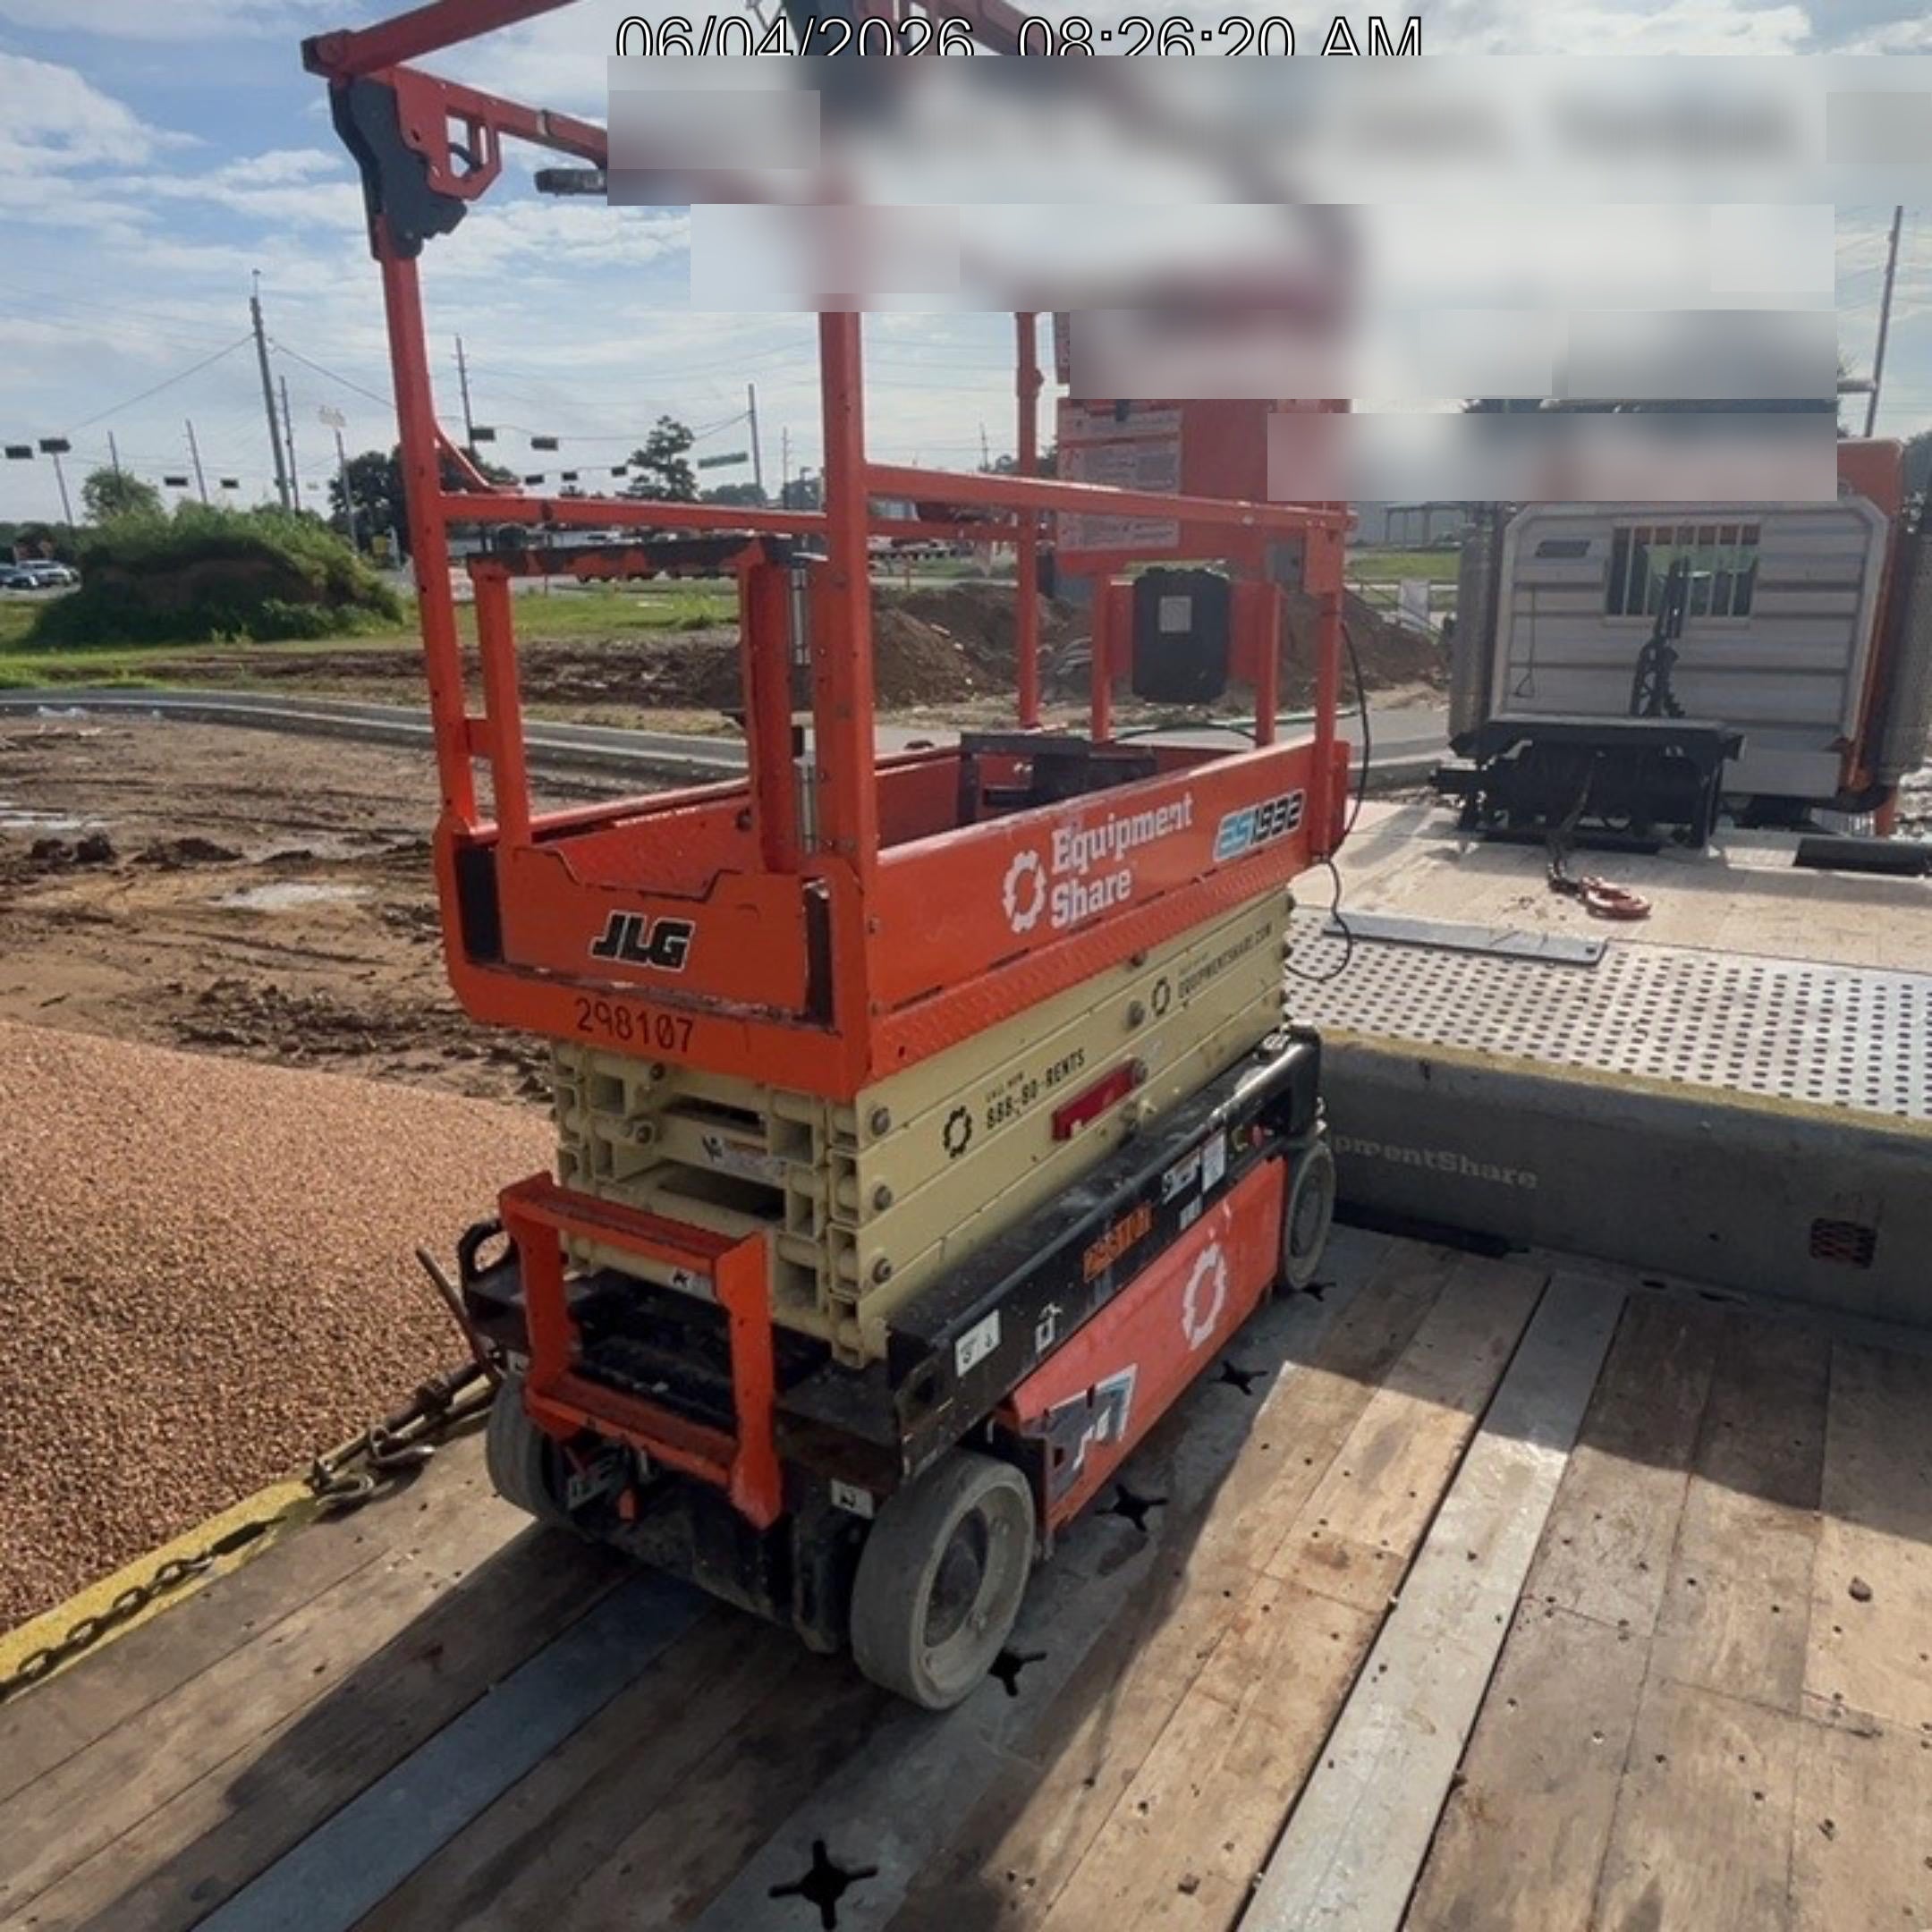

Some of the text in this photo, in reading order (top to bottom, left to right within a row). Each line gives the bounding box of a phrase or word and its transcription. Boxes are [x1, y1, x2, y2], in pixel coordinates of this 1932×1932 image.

[1051, 792, 1192, 875] Equipment
[1050, 868, 1132, 928] Share
[590, 909, 696, 972] JLG
[575, 996, 694, 1053] 298107
[1334, 1134, 1539, 1190] pmentShare
